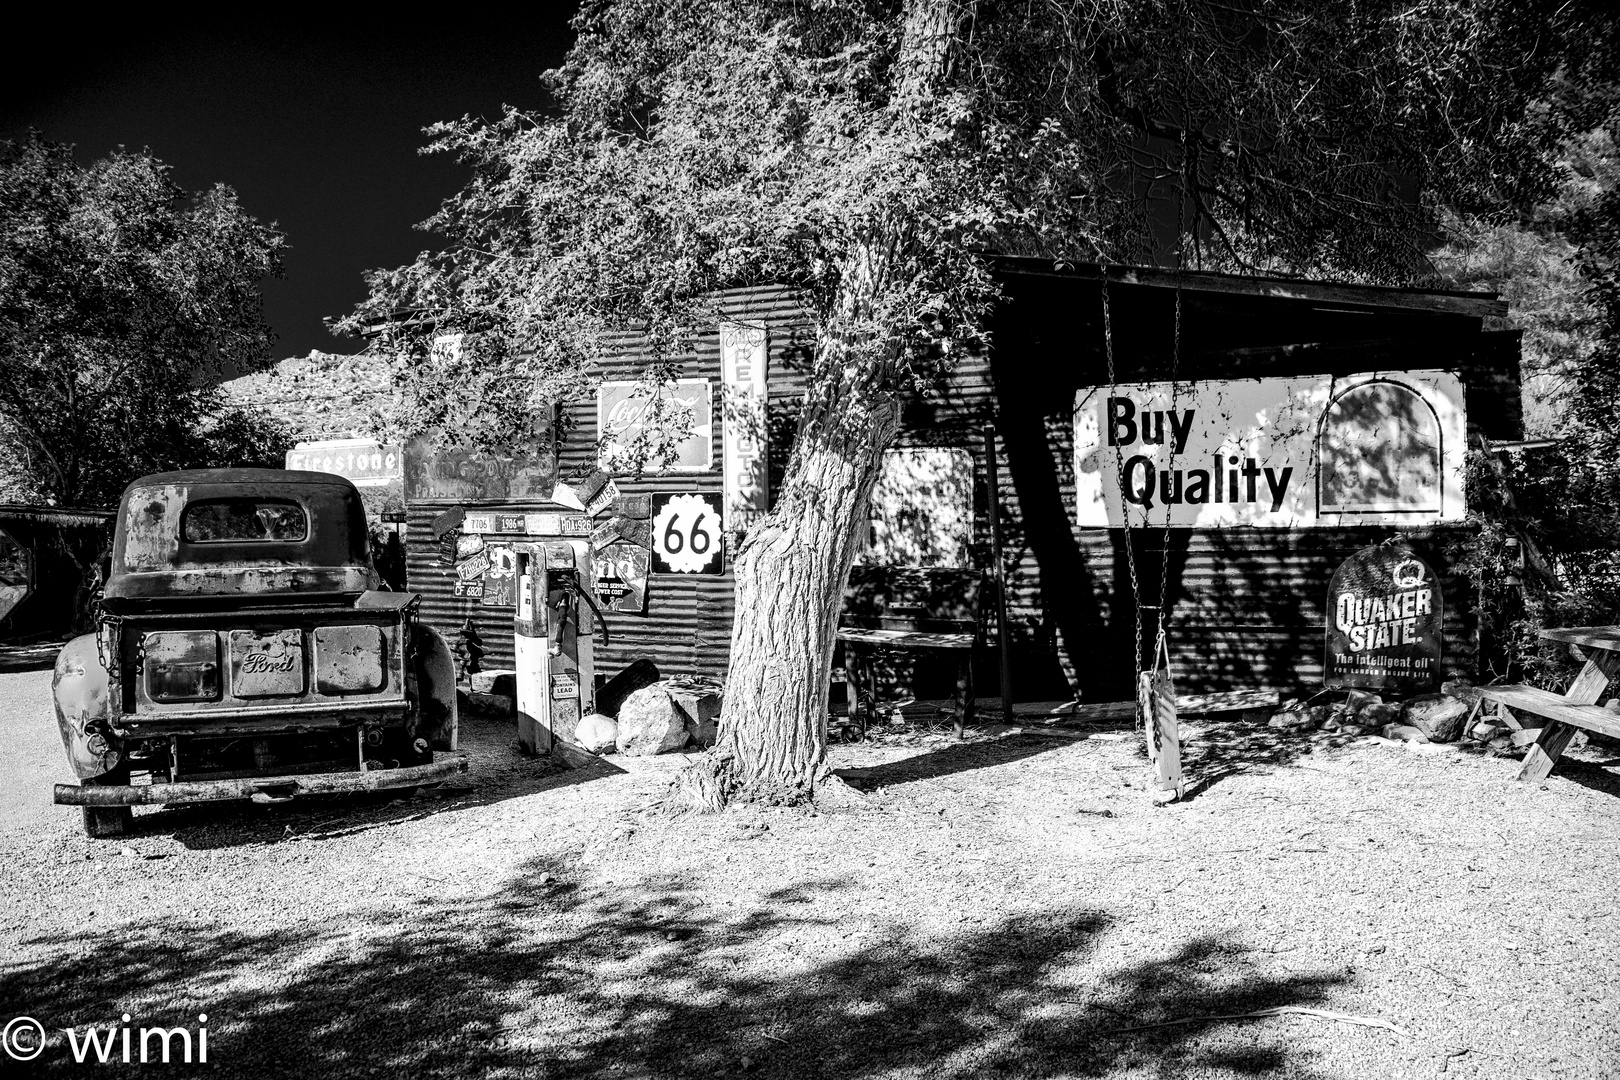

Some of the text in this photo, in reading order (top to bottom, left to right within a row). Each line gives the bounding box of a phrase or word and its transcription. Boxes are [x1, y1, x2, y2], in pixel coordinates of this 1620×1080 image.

[1107, 397, 1195, 454] Buy
[290, 452, 396, 472] Firestone
[1122, 454, 1293, 512] Quality
[664, 513, 710, 554] 66
[1336, 589, 1432, 636] QUAKER
[242, 652, 294, 673] Ford
[1335, 653, 1428, 668] The intelligent oil
